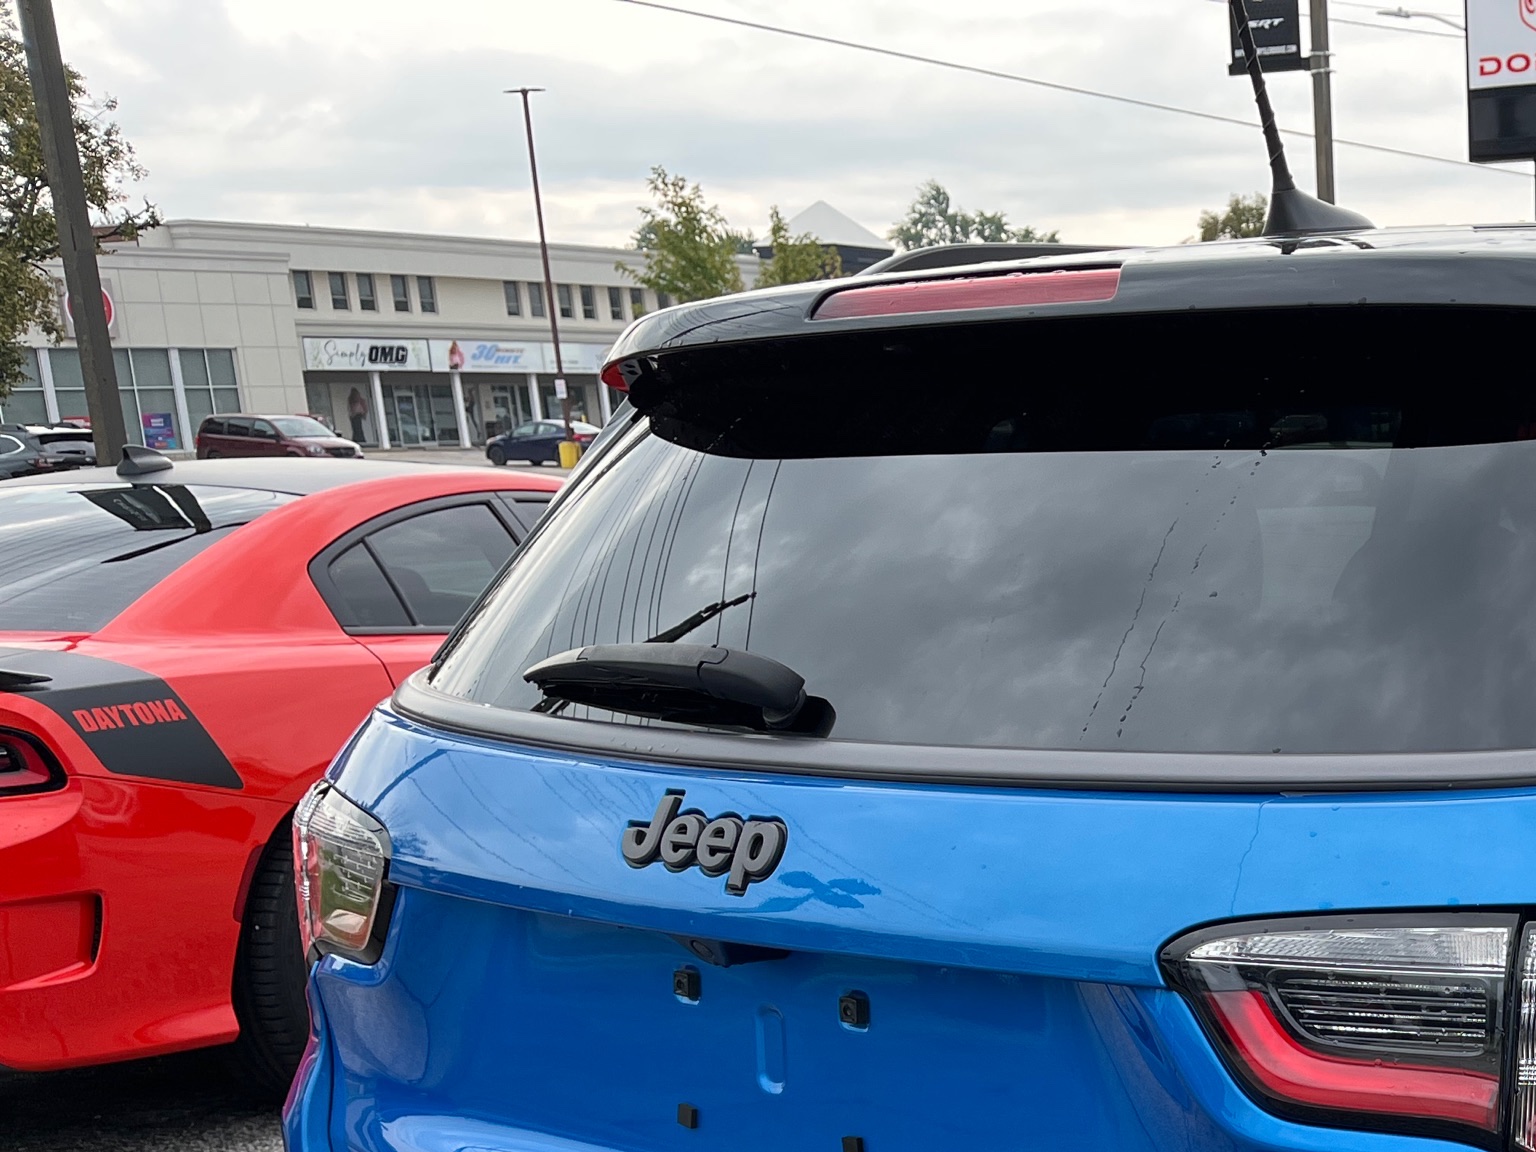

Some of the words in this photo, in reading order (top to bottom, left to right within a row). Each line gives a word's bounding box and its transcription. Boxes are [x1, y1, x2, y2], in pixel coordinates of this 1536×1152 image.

[323, 339, 367, 368] Simply
[368, 344, 408, 364] OMG
[470, 343, 500, 361] 30
[72, 698, 188, 733] DAYTONA
[621, 788, 788, 898] Jeep
